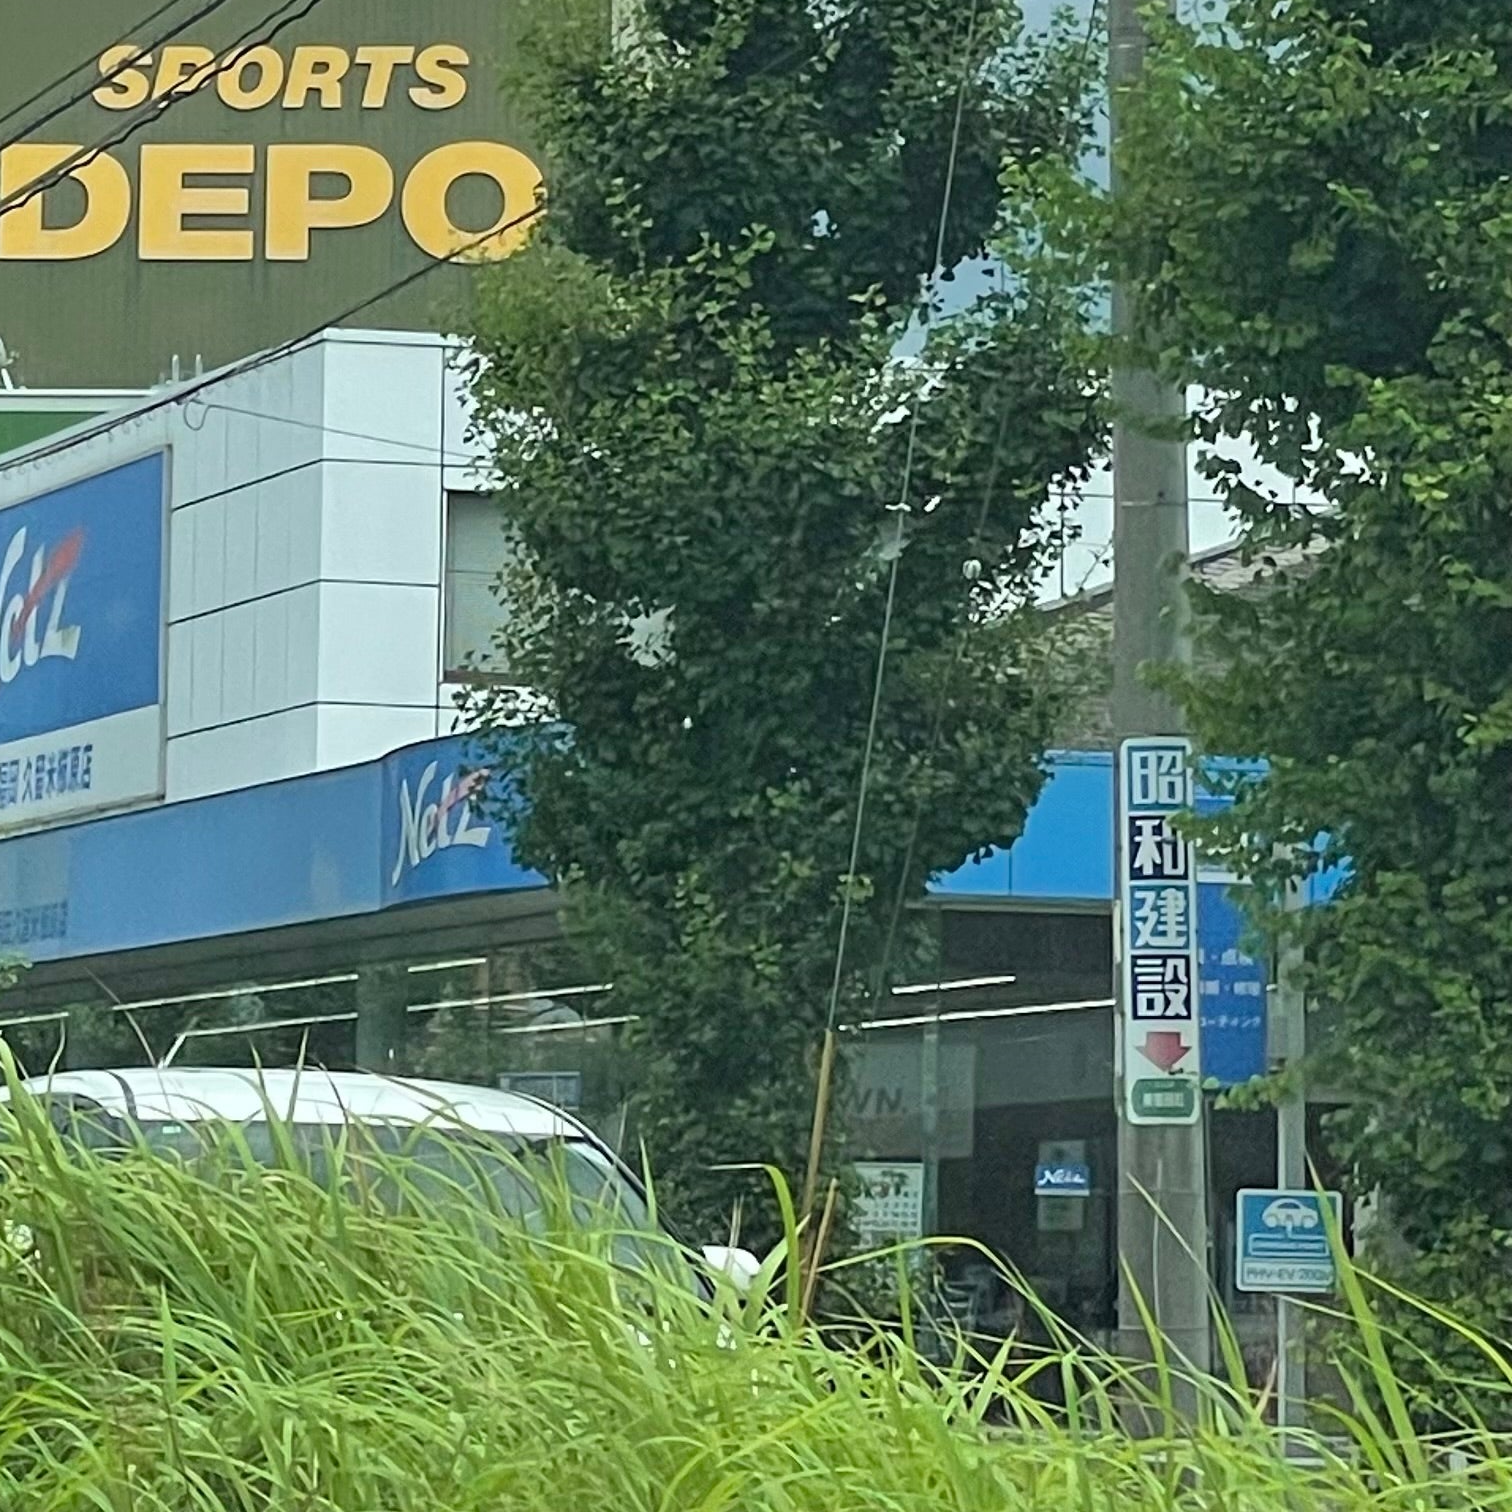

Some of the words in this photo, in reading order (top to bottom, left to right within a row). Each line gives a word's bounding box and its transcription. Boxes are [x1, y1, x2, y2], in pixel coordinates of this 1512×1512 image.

[90, 44, 470, 111] SPORTS
[391, 759, 492, 887] Netz
[1130, 750, 1190, 1019] 昭和建設
